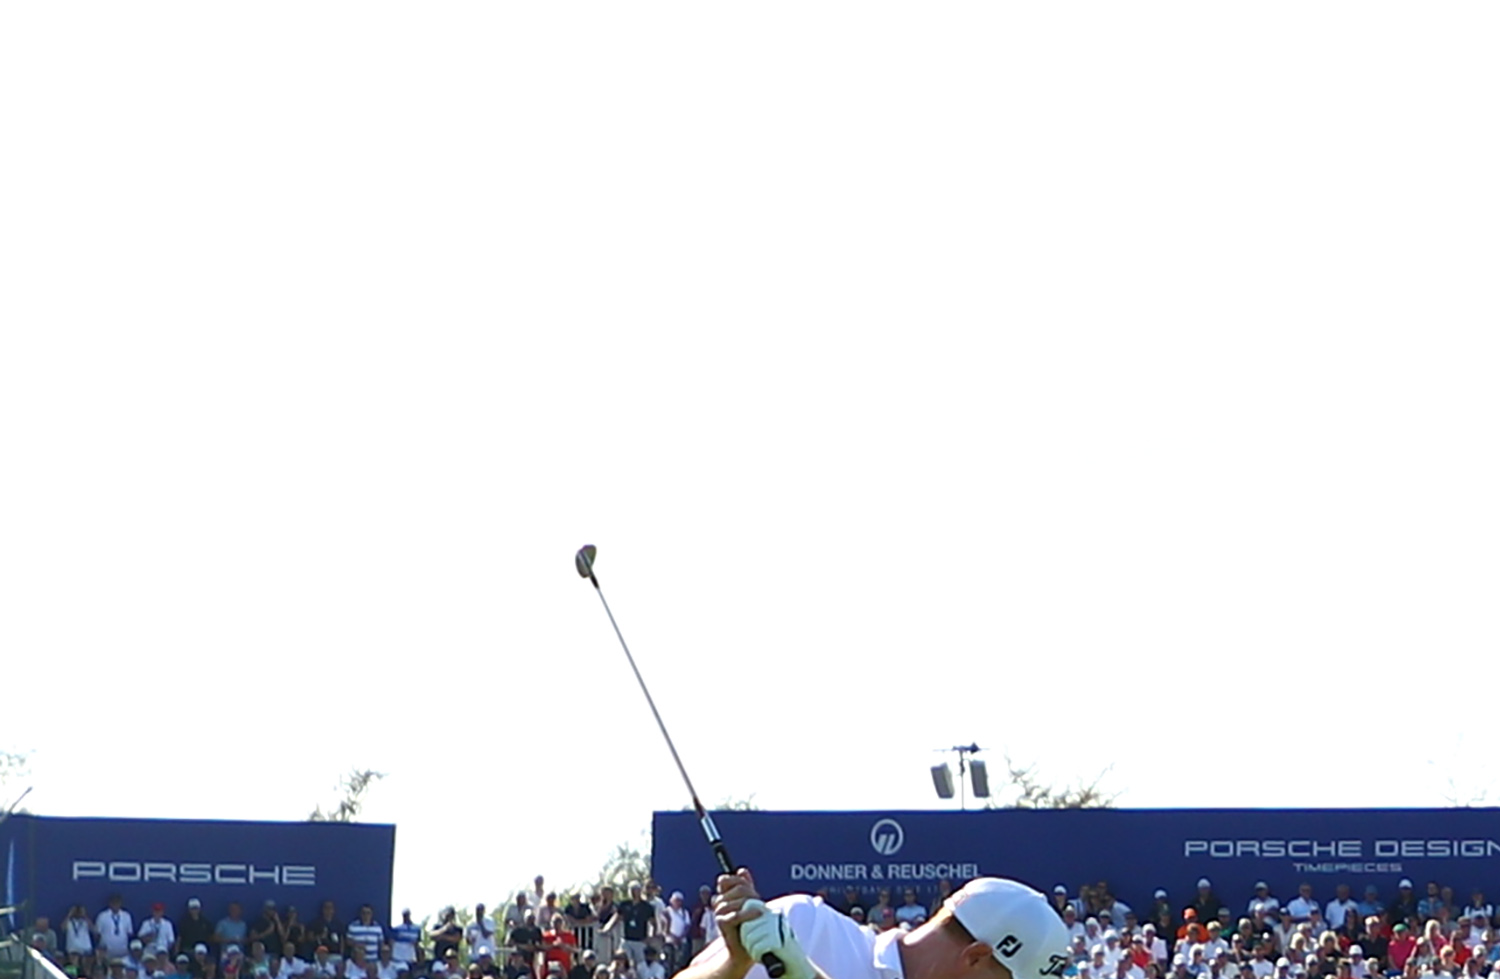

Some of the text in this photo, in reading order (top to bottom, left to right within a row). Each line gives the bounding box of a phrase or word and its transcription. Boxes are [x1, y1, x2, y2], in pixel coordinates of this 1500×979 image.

[1185, 840, 1362, 857] PORSCHE
[72, 861, 316, 885] PORSCHE
[791, 863, 981, 880] DONNER & REUSCHEL
[1293, 863, 1403, 873] TIMEPIECES
[995, 934, 1023, 958] FJ
